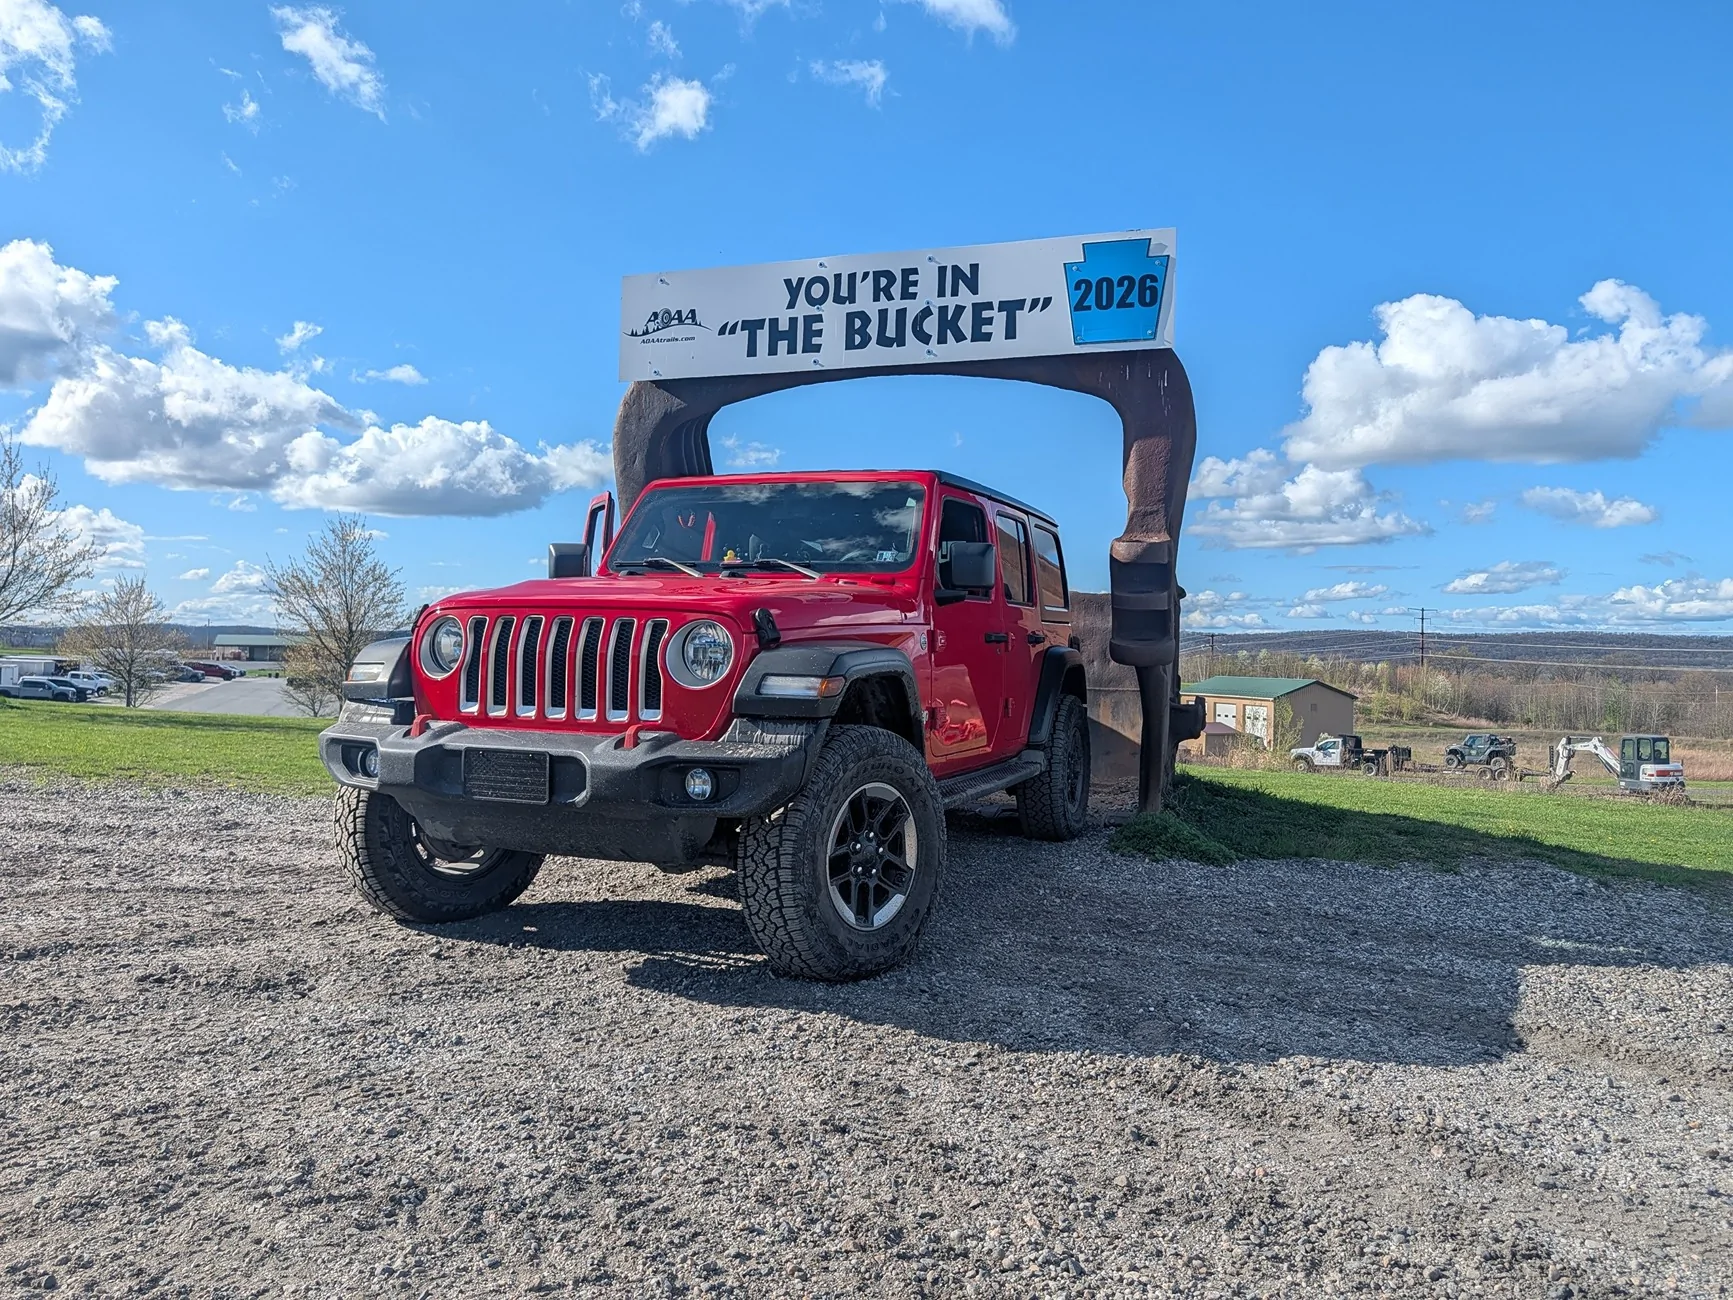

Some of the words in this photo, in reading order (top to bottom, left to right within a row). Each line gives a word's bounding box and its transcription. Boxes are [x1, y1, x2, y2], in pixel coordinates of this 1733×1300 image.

[783, 267, 919, 310] YOU'RE
[936, 262, 980, 298] IN
[1073, 273, 1160, 313] 2026
[644, 307, 697, 328] AOAA
[639, 335, 696, 345] AOAAtrails.com
